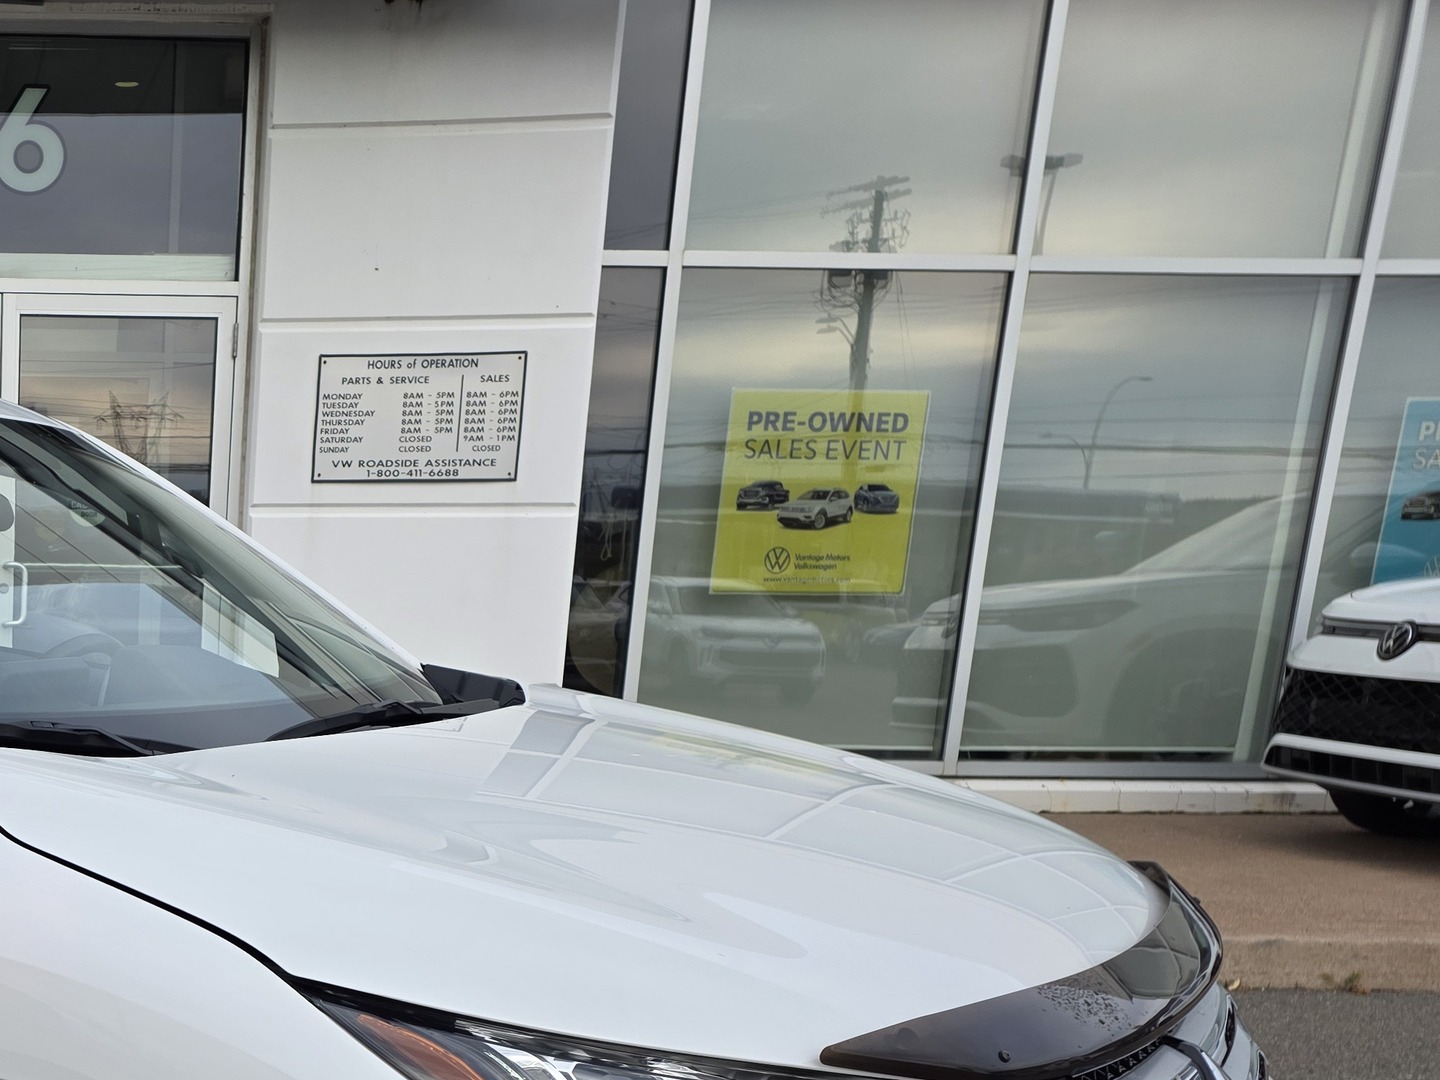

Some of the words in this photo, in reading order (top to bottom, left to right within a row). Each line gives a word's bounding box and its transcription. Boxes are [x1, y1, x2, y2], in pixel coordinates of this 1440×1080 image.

[367, 359, 402, 370] HOURS
[407, 358, 417, 370] of
[421, 358, 479, 369] OPERATION
[341, 376, 372, 385] PARTS
[376, 376, 384, 385] &
[389, 375, 430, 384] SERVICE
[480, 374, 510, 383] SALES
[435, 391, 455, 399] 5PM
[499, 390, 519, 398] 6PM
[434, 400, 454, 408] 5PM
[498, 399, 519, 407] 6PM
[402, 409, 423, 417] 8AM
[465, 408, 486, 416] 8AM
[498, 408, 518, 416] 6PM
[434, 417, 454, 425] 5PM
[464, 417, 486, 425] 8AM
[747, 410, 909, 433] PRE-OWNED
[400, 426, 422, 434] 8AM
[434, 426, 453, 434] 5PM
[496, 425, 516, 433] 6PM
[320, 436, 364, 444] SATURDAY
[496, 434, 516, 442] 1PM
[398, 445, 432, 453] CLOSED
[744, 438, 817, 460] SALES
[825, 439, 907, 461] EVENT
[331, 460, 353, 468] VW
[358, 459, 419, 468] ROADSIDE
[425, 459, 497, 467] ASSISTANCE
[366, 469, 459, 478] 1-800-411-6688
[795, 553, 825, 562] Vantage
[825, 553, 851, 562] Motors
[794, 562, 837, 572] Volkswagen
